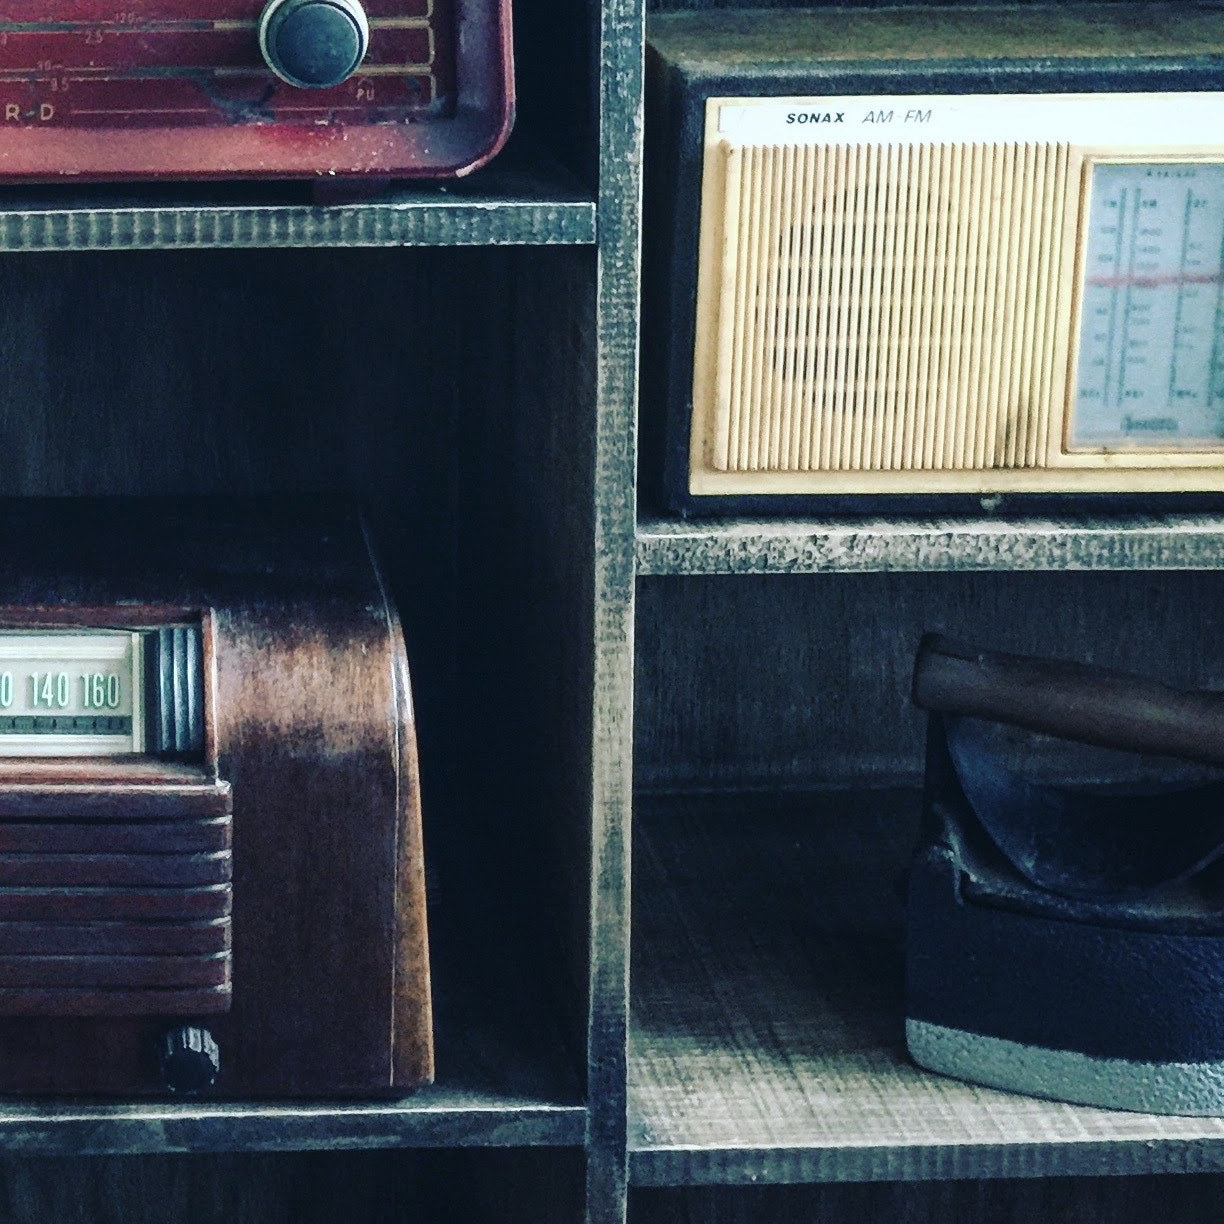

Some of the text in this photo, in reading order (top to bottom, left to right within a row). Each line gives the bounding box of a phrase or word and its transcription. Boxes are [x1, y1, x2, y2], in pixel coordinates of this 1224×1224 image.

[785, 109, 933, 124] SONAX AM FM
[30, 672, 70, 707] 140
[81, 673, 120, 708] 160
